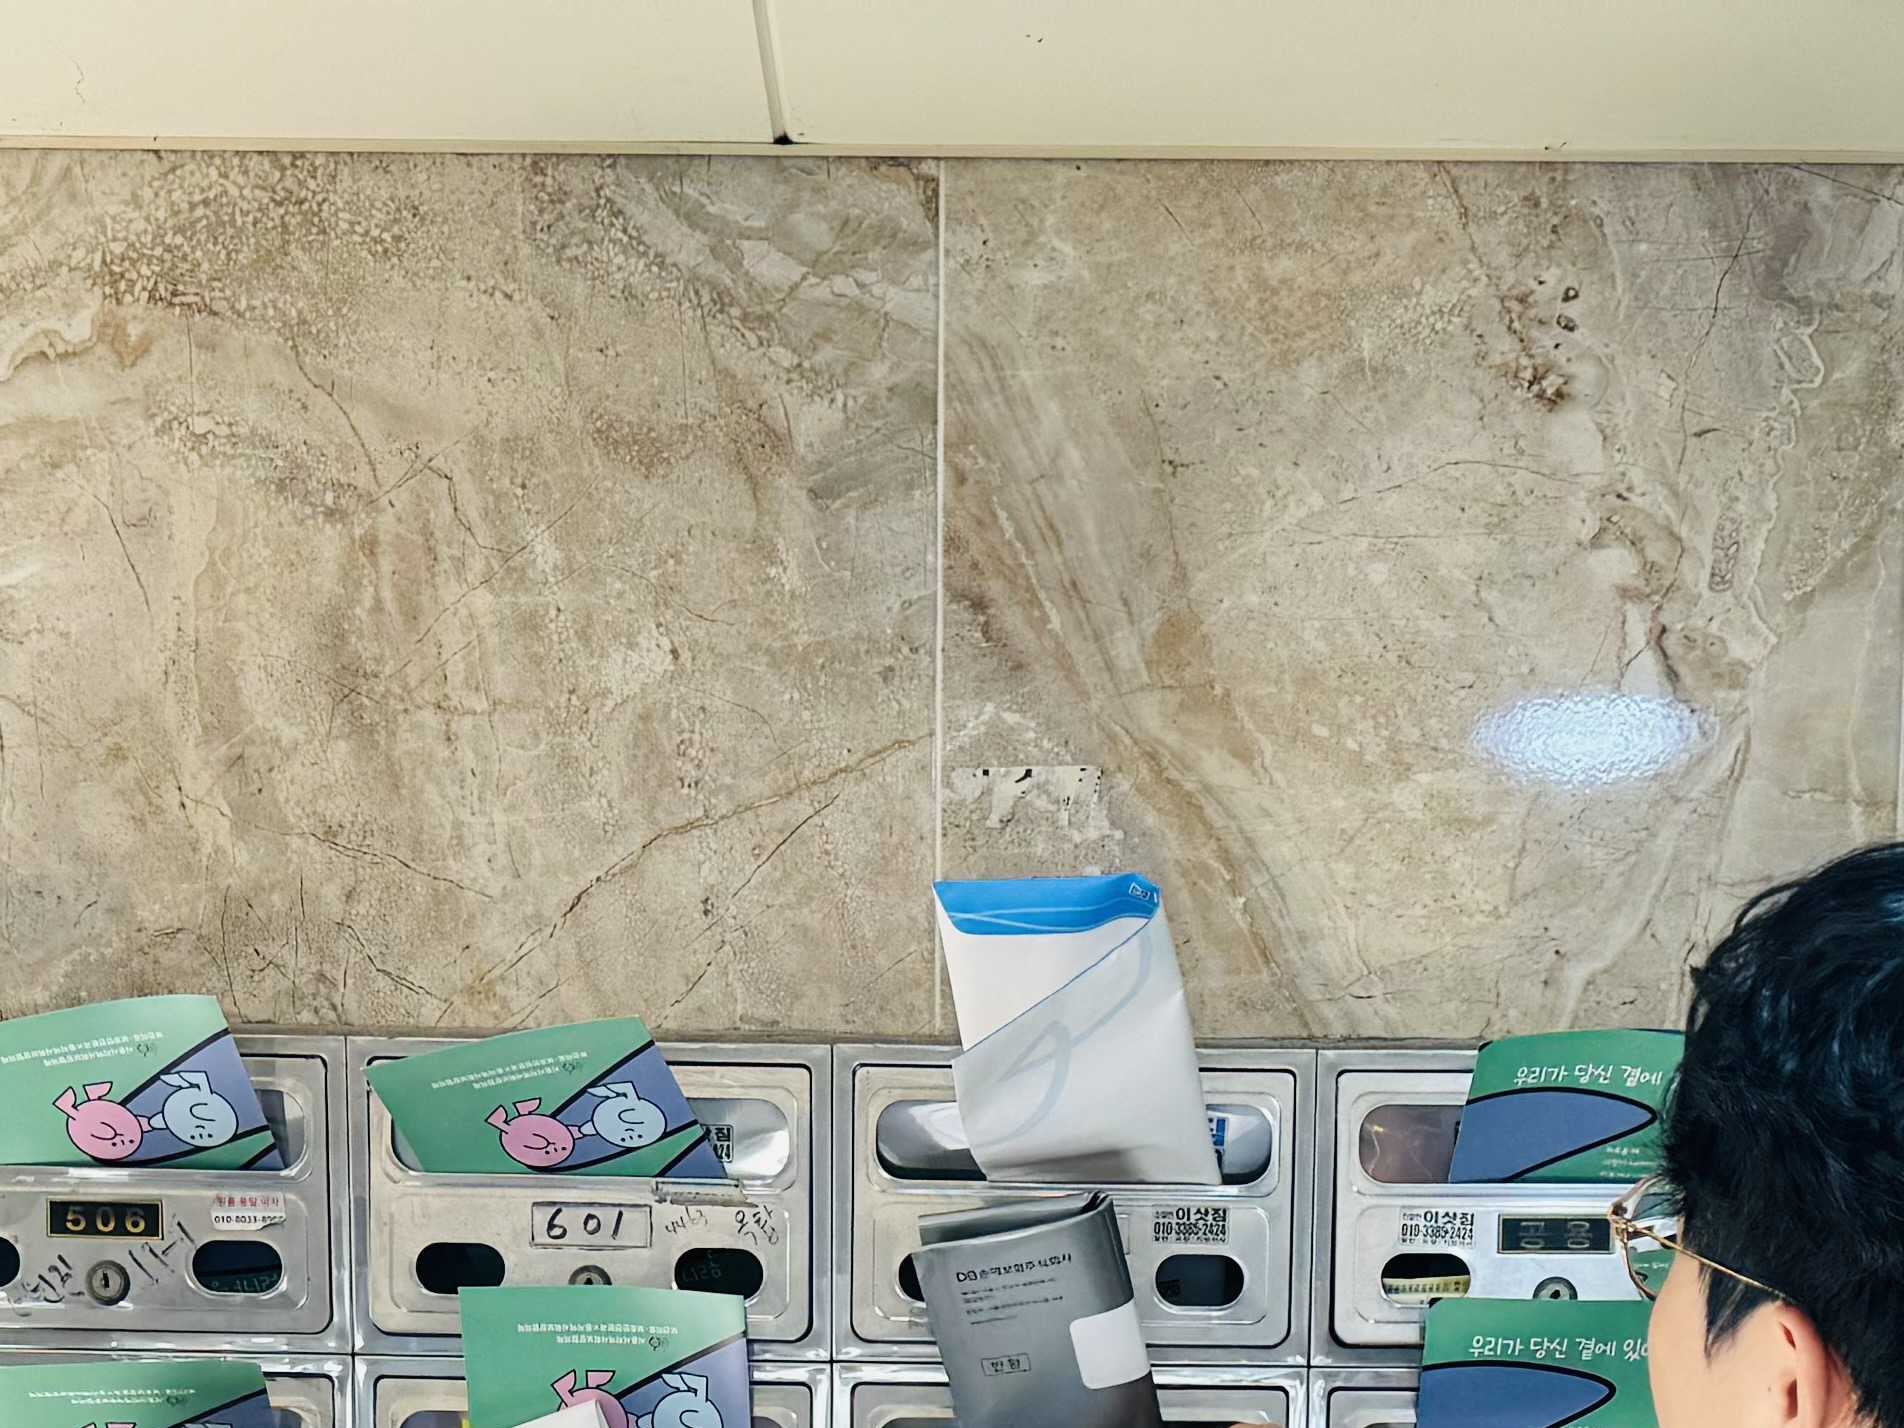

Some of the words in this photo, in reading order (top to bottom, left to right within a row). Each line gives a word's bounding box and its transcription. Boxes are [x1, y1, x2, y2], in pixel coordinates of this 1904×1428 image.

[1514, 1065, 1568, 1086] 우리가
[1574, 1063, 1614, 1085] 당신
[65, 1205, 146, 1234] 506
[545, 1207, 625, 1241] 601
[1423, 1210, 1475, 1226] 이삿짐
[1468, 1335, 1524, 1358] 우리가
[1529, 1337, 1568, 1359] 당신
[1575, 1337, 1616, 1361] 곁에
